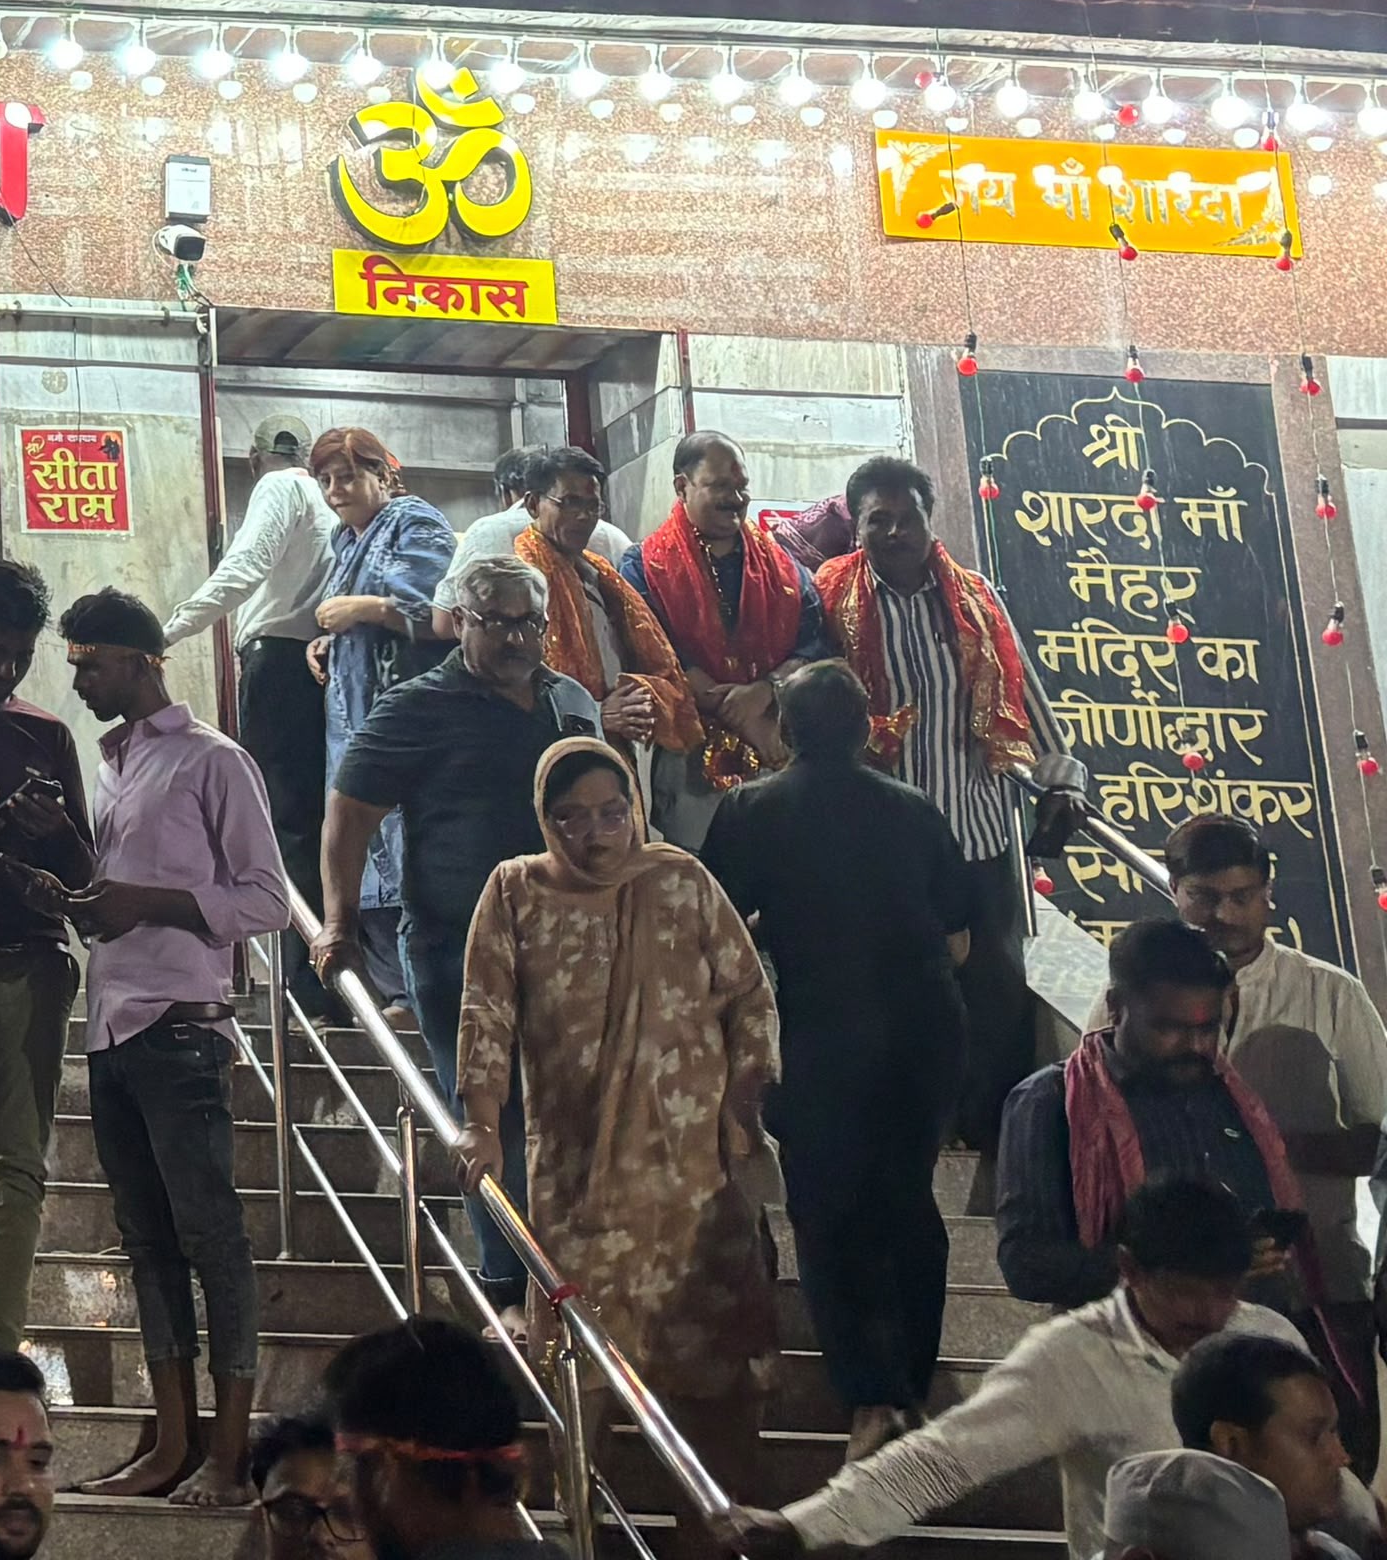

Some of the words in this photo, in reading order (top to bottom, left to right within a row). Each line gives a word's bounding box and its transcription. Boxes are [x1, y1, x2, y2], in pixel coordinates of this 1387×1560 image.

[938, 167, 1017, 219] जय
[1099, 176, 1243, 229] शारदा
[358, 255, 529, 318] निकास
[29, 448, 119, 491] सीता
[1081, 413, 1144, 472] श्री
[36, 493, 116, 524] राम
[1014, 490, 1165, 550] शारदा
[1173, 485, 1248, 544] माँ
[1065, 547, 1202, 624] मैहर
[1033, 617, 1182, 694] मंदिर
[1190, 636, 1261, 685] का
